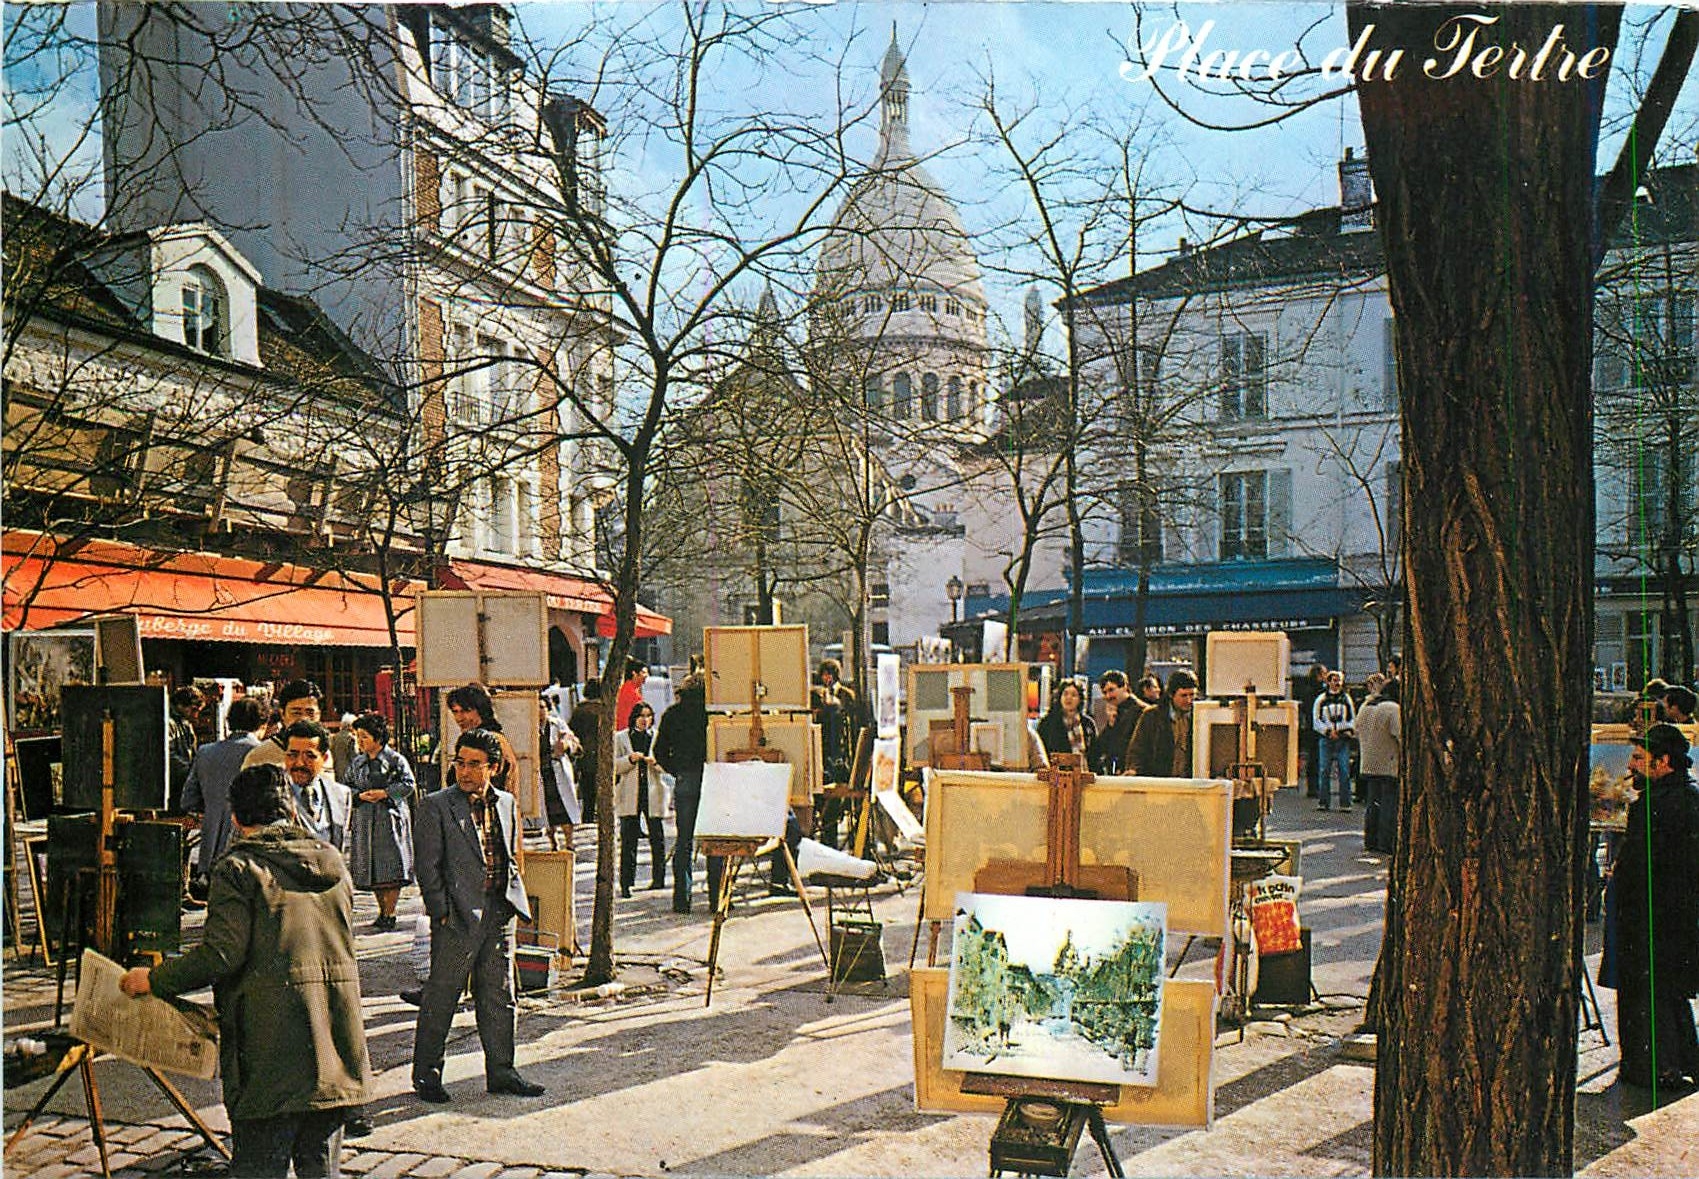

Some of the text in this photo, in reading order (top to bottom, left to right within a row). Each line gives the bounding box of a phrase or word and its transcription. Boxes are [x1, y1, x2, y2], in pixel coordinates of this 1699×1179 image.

[137, 616, 335, 643] uberge du Village
[1088, 619, 1309, 636] AU CLIRON DES CHASSEURS
